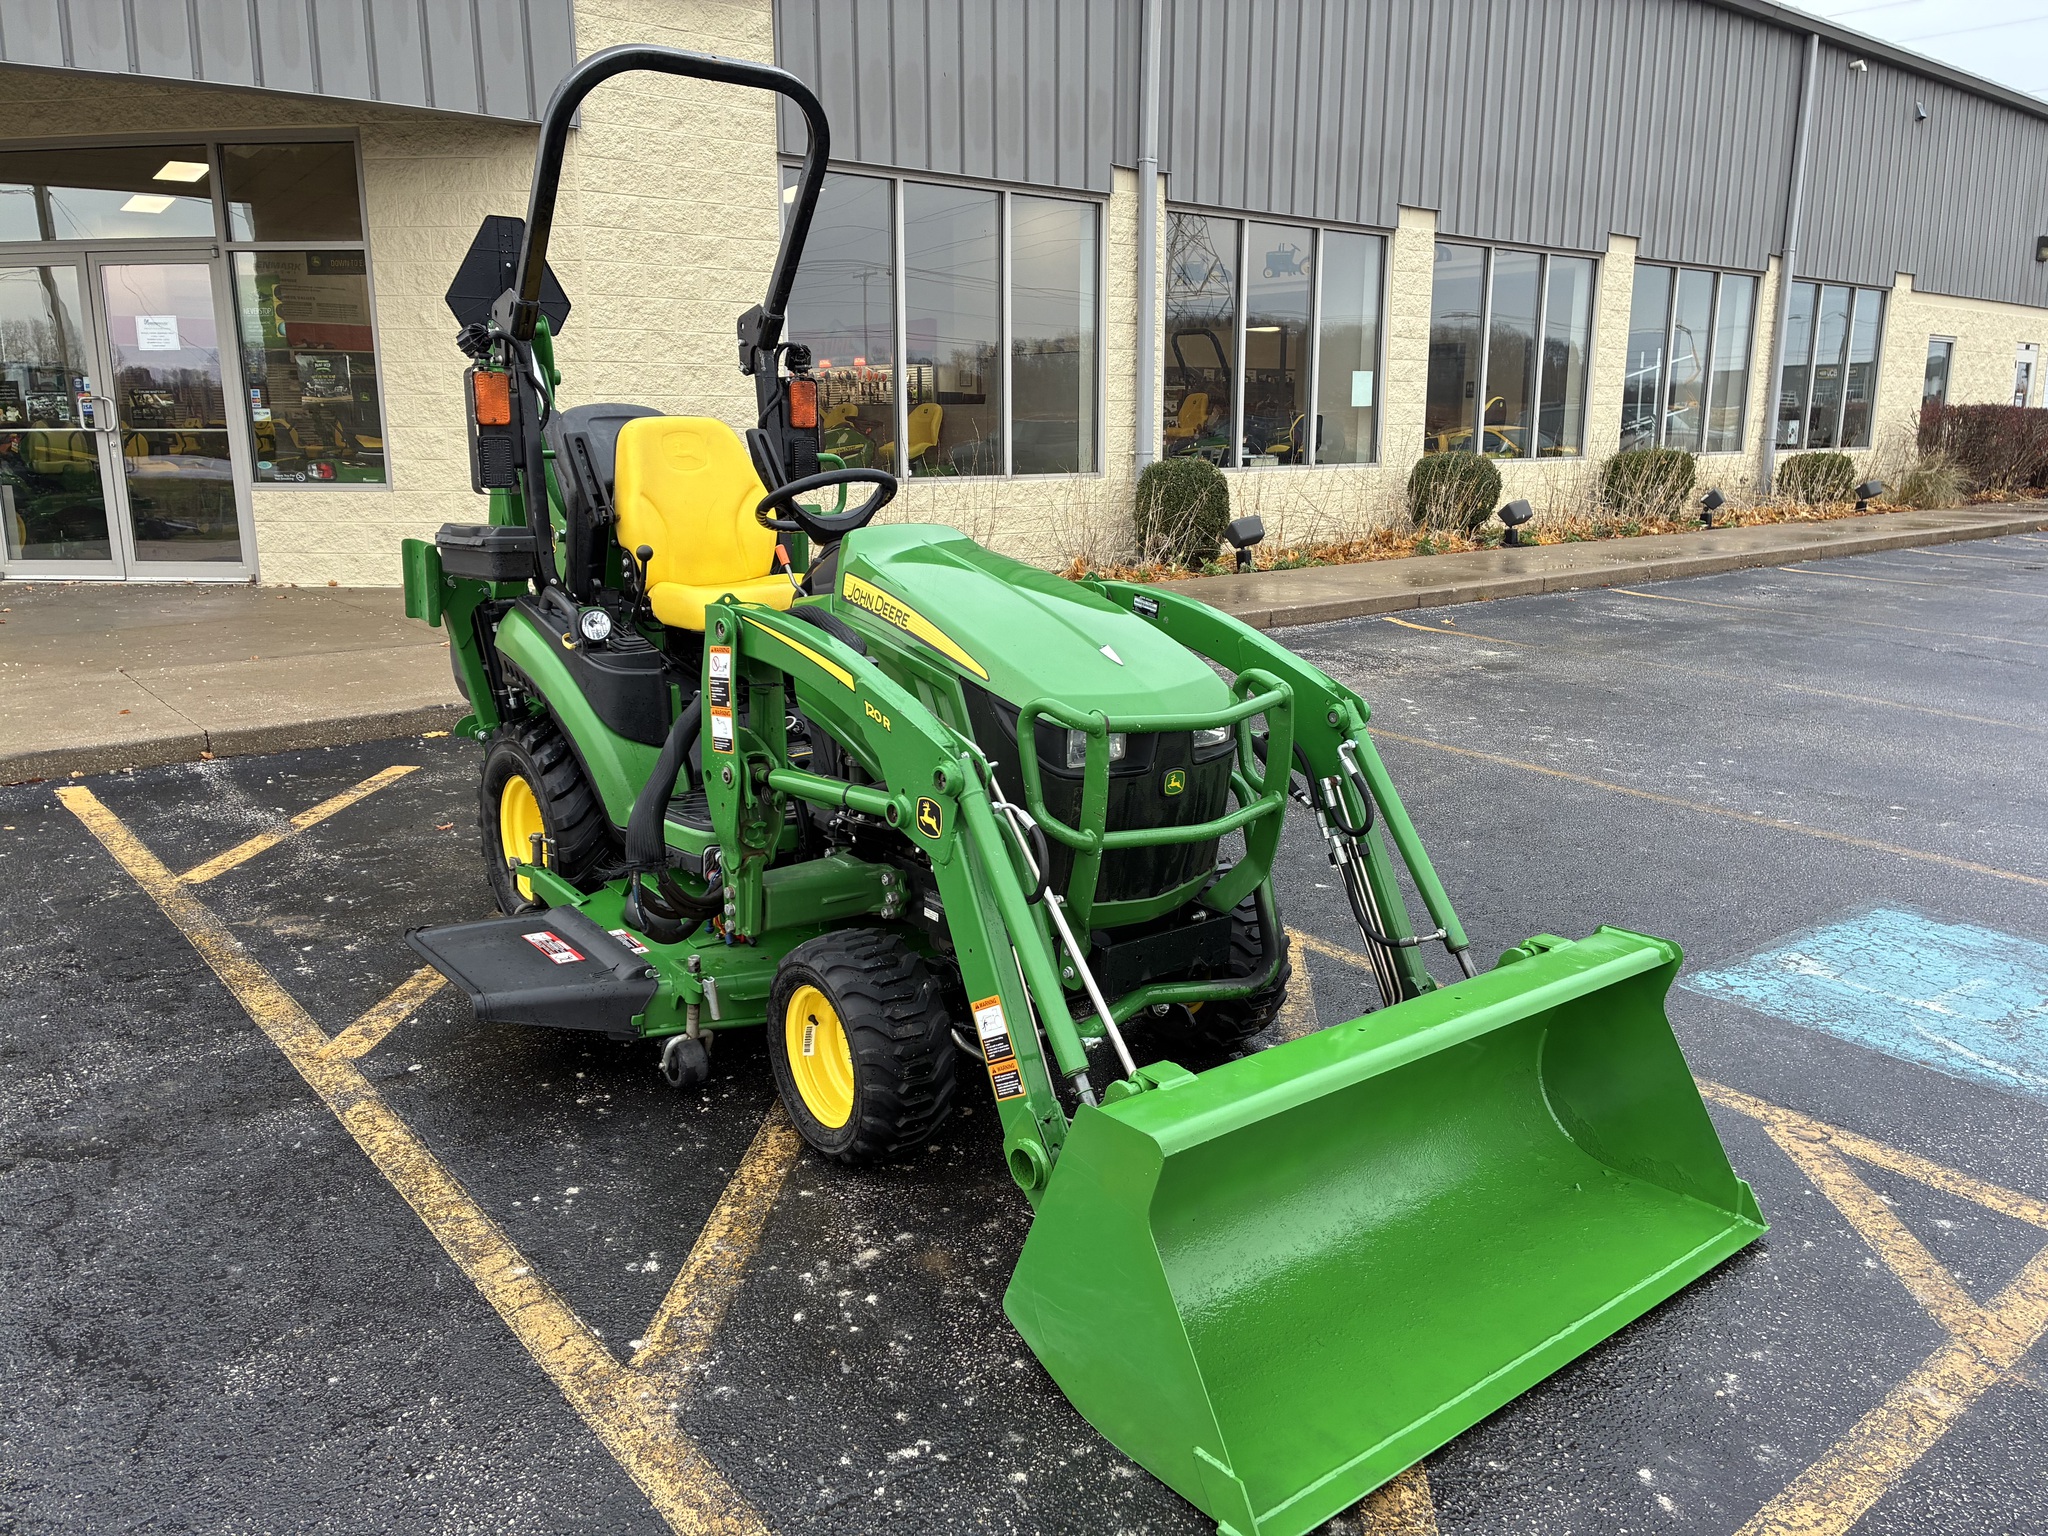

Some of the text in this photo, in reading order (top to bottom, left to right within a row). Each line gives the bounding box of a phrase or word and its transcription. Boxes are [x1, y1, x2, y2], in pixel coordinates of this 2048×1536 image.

[848, 584, 910, 628] JOHN DEERE
[979, 998, 996, 1007] WARNING
[997, 1062, 1015, 1072] WARNING
